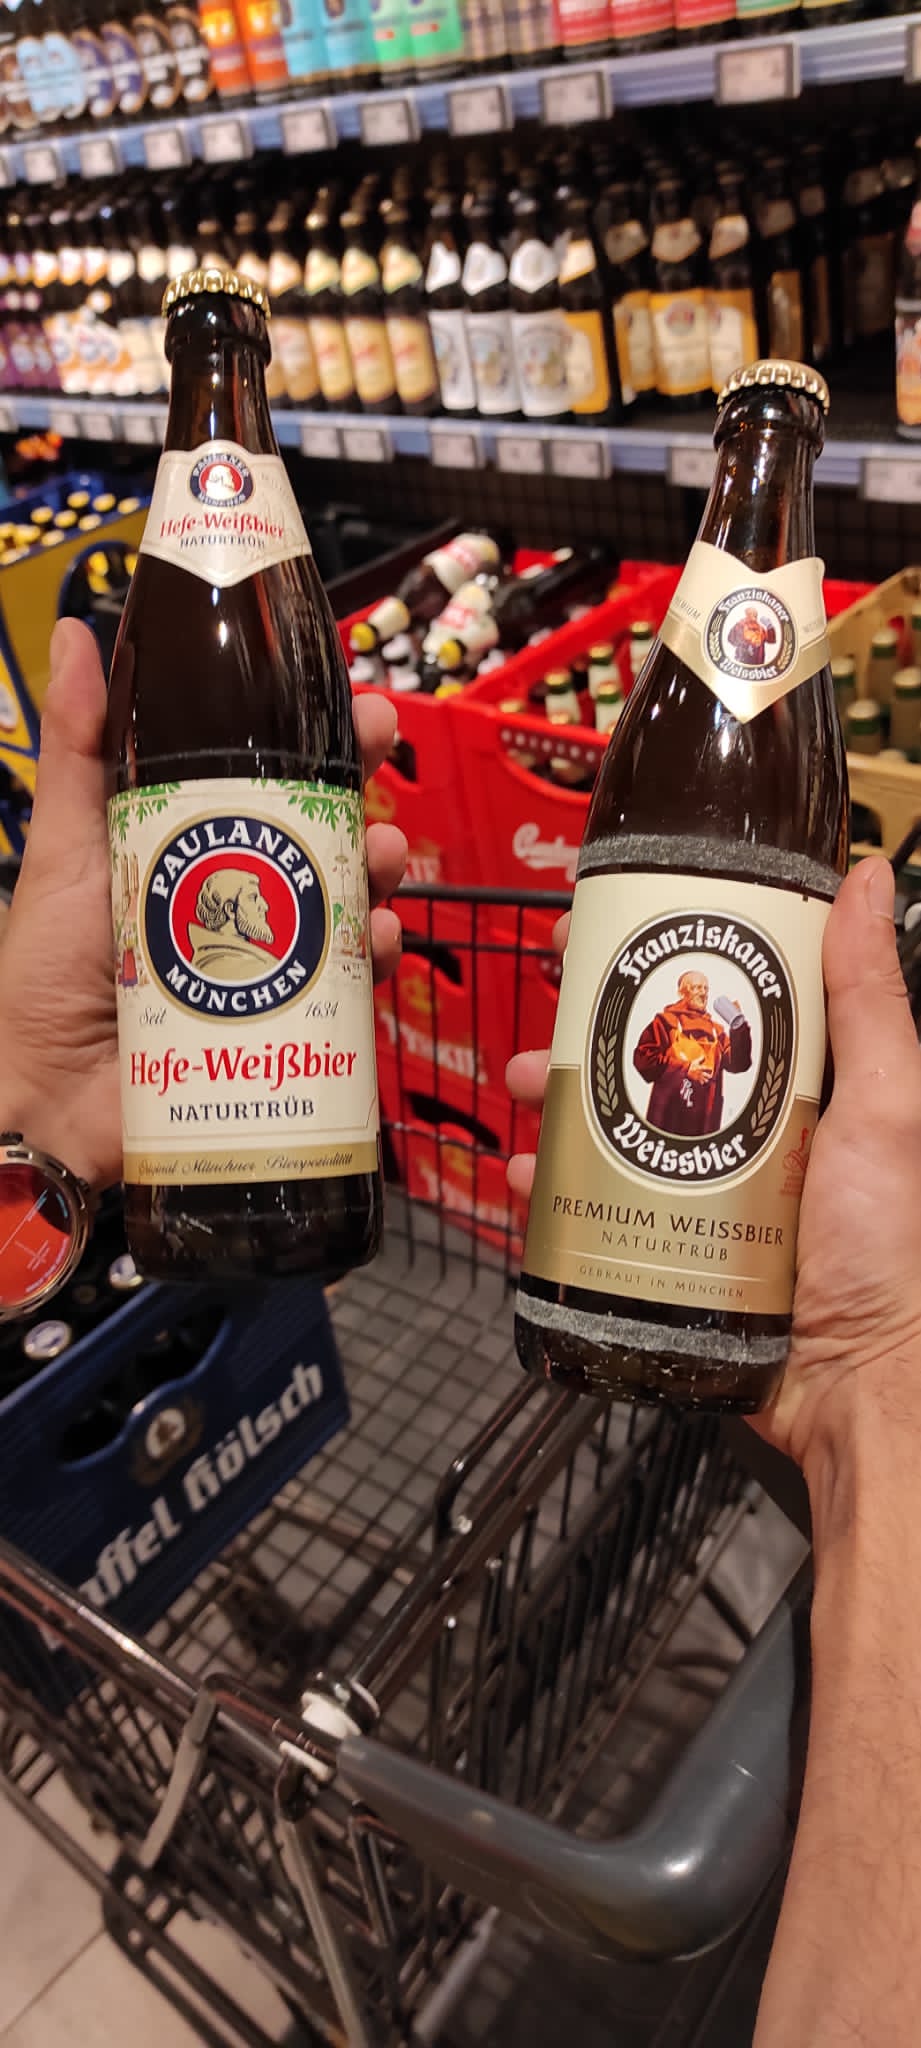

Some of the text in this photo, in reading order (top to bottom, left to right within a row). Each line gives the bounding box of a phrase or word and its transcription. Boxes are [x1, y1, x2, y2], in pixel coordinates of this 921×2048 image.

[160, 512, 284, 540] Hefe-Weißbier
[718, 589, 789, 622] Franziskaner
[719, 659, 778, 680] Weissbier
[151, 819, 315, 900] PAULANER
[617, 918, 783, 1000] Franziskaner
[165, 959, 308, 1013] MÜNCHEN
[139, 1000, 339, 1027] Seit 1634
[130, 1041, 357, 1096] Hefe-Weißbier
[169, 1096, 315, 1124] NATURTRÜB
[612, 1112, 749, 1177] Weissbier
[552, 1195, 656, 1230] PREMIUM
[670, 1213, 784, 1246] WEISSBIER
[601, 1230, 729, 1261] NATURTRÜB
[579, 1264, 744, 1298] GEBRAUT IN MÜNCHEN
[77, 1496, 182, 1608] affel
